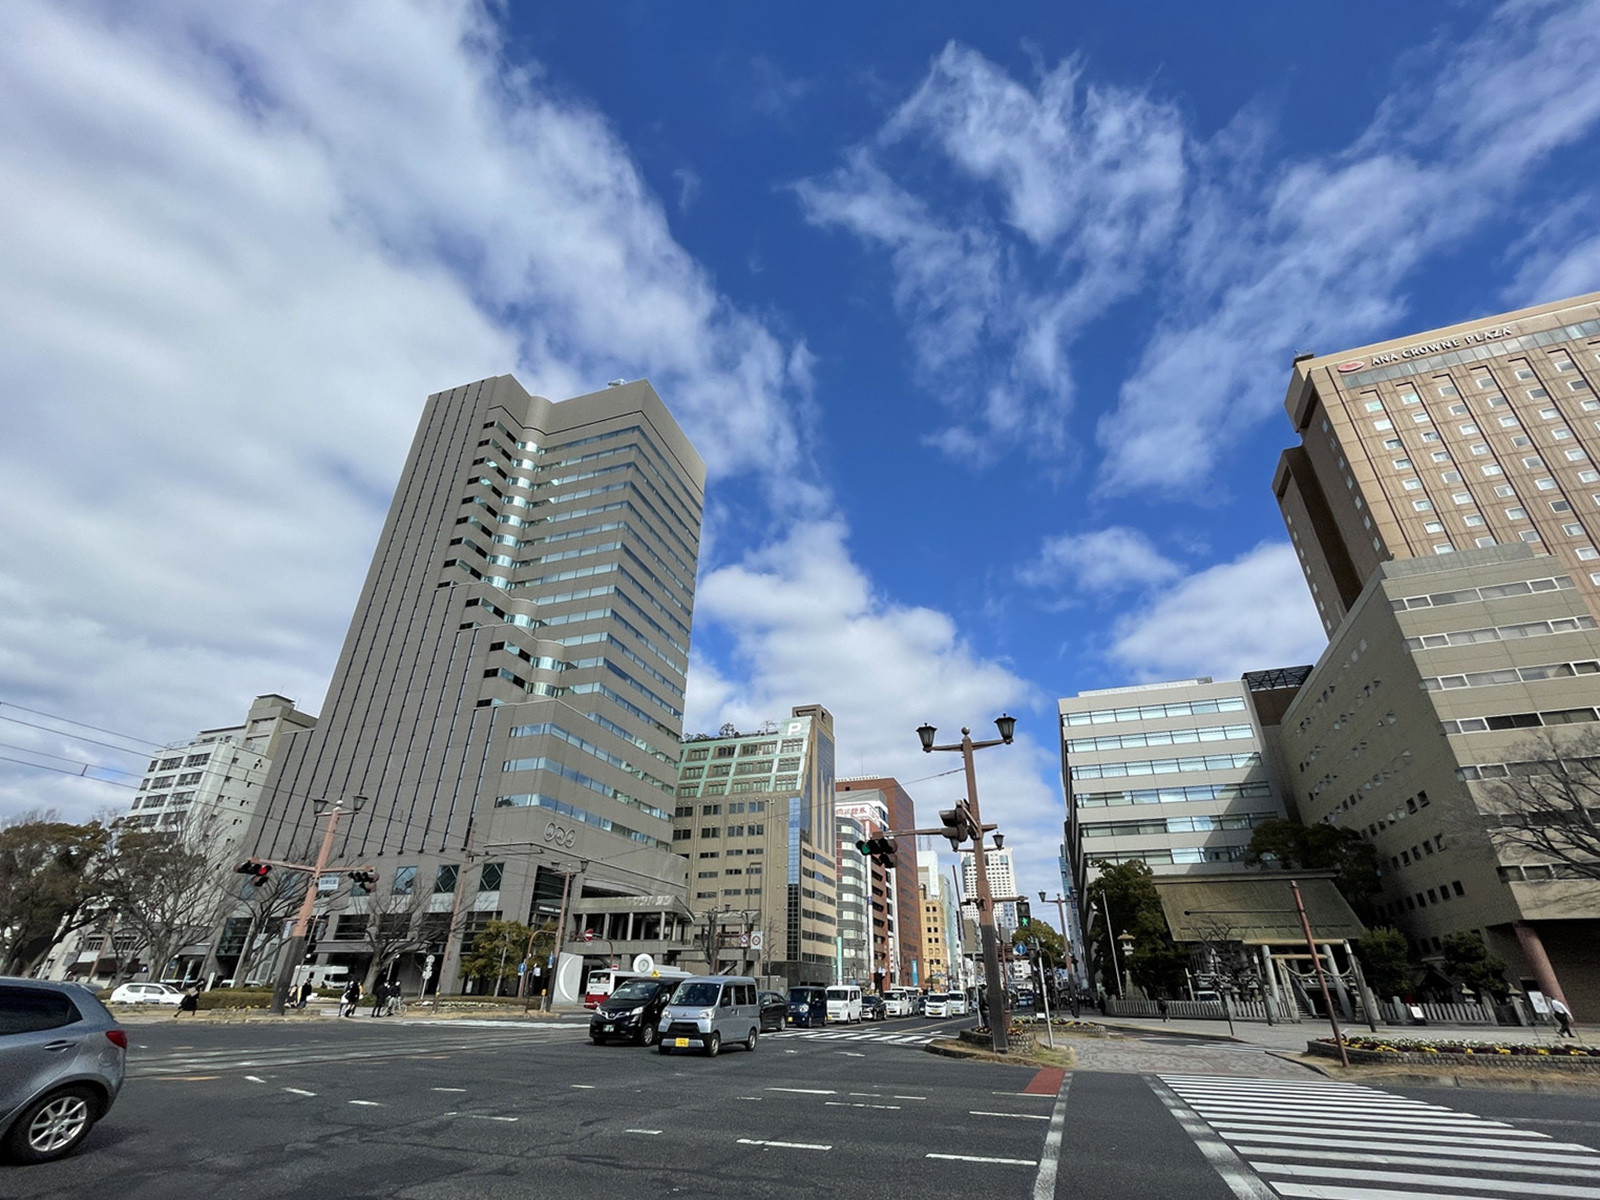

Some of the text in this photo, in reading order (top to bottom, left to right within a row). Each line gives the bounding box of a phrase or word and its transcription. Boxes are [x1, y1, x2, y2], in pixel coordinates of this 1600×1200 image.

[1371, 327, 1512, 366] ANA CROWNE PLAZA
[787, 722, 801, 736] P
